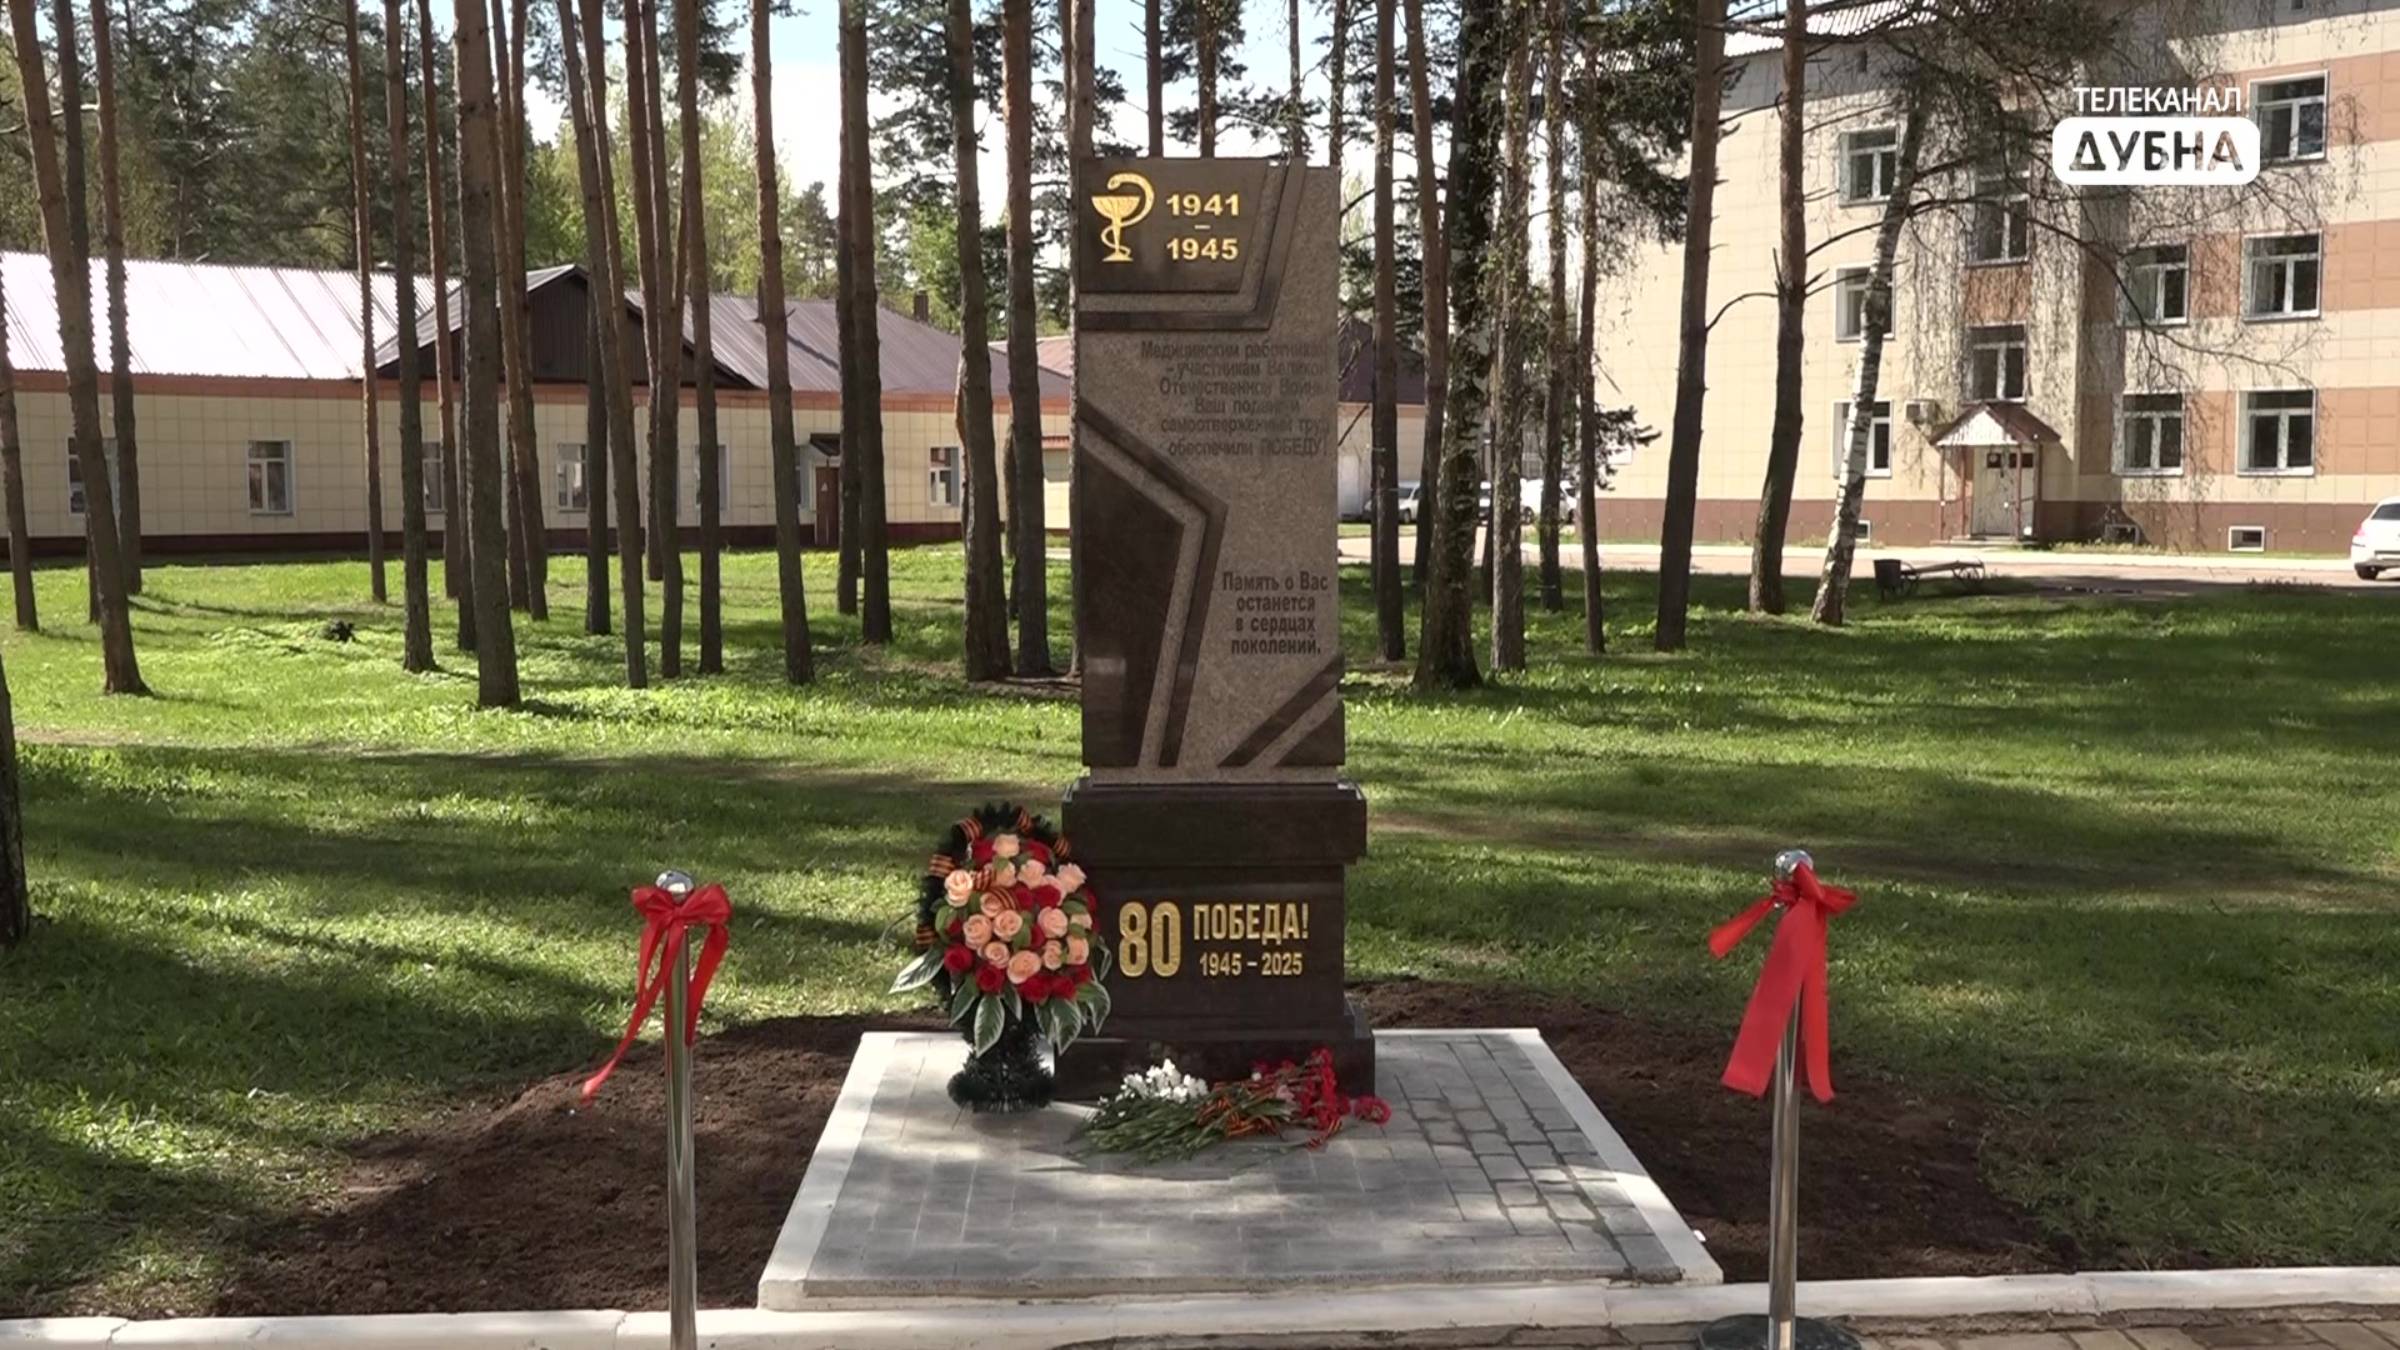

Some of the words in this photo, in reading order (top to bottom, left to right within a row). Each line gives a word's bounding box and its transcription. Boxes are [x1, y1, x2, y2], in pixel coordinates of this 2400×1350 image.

[1166, 194, 1240, 216] 1941
[1166, 238, 1239, 260] 1945
[1222, 572, 1280, 591] Память
[1285, 577, 1294, 591] о
[1300, 571, 1328, 590] Вас
[1236, 597, 1316, 612] останется
[1236, 619, 1244, 632] в
[1251, 617, 1316, 636] сердцах
[1231, 634, 1321, 655] поколений.
[1119, 901, 1181, 977] 80
[1193, 903, 1309, 945] ПОБЕДА!
[1199, 952, 1242, 976] 1945
[1262, 952, 1302, 976] 2025
